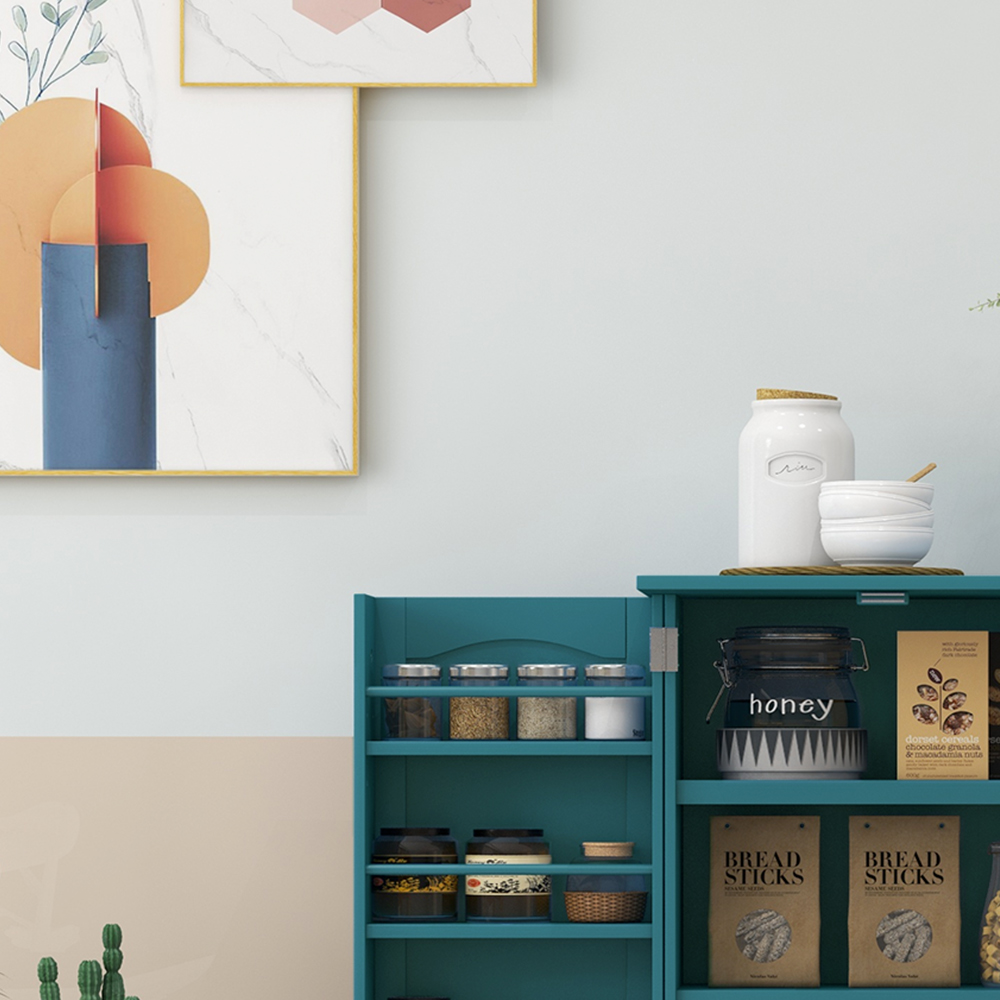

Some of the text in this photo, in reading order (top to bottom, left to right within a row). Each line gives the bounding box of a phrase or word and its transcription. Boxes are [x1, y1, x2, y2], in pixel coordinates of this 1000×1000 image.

[750, 693, 833, 721] honey
[906, 735, 979, 744] dorset cereals
[906, 743, 946, 751] chocolate
[947, 743, 981, 753] granola
[906, 751, 913, 759] &
[915, 751, 962, 759] macadamia
[965, 751, 983, 759] nuts
[724, 851, 801, 867] BREAD
[864, 851, 941, 867] BREAD
[724, 868, 804, 885] STICKS
[864, 868, 944, 885] STICKS
